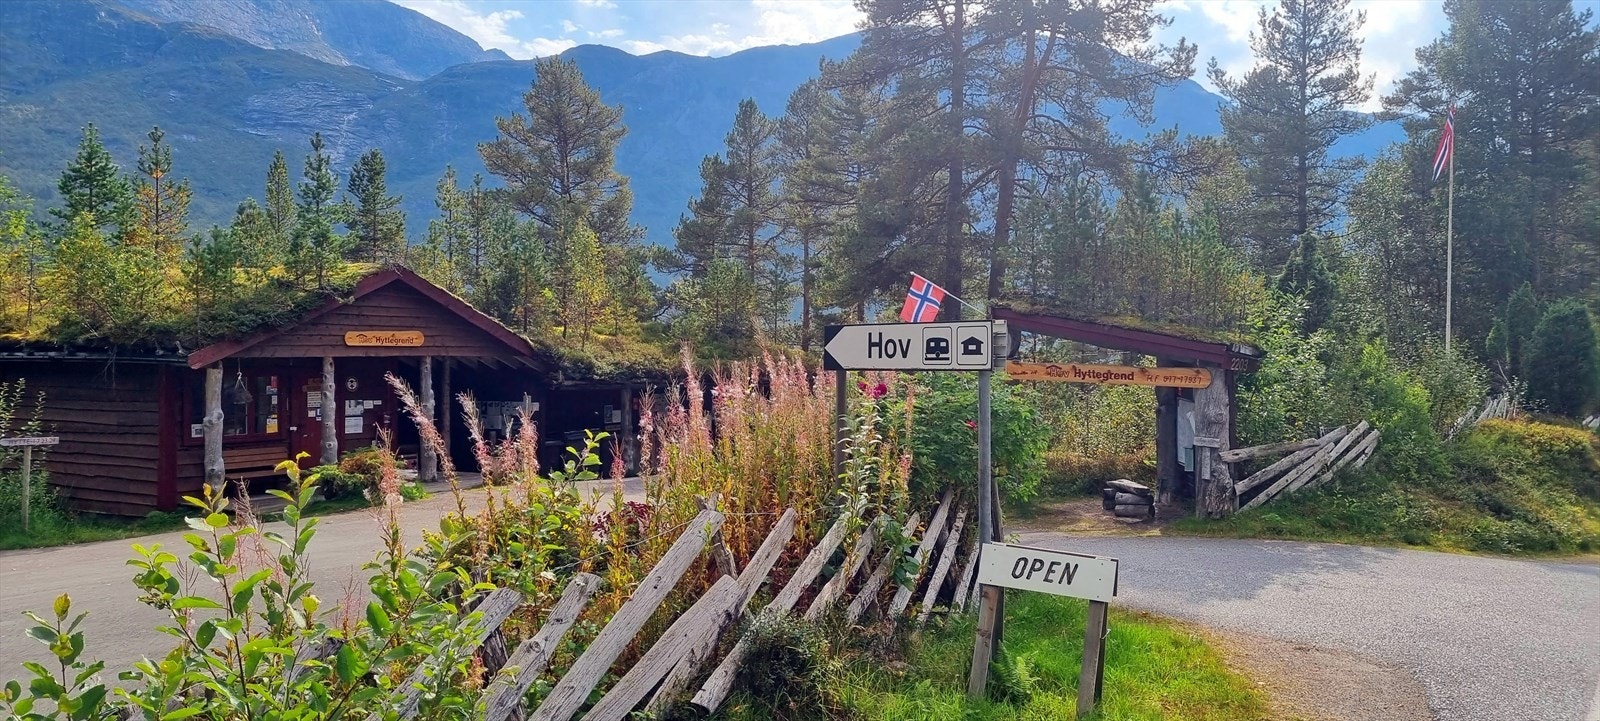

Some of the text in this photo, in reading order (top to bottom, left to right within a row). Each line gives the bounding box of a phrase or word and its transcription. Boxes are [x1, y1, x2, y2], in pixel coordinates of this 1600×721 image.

[375, 336, 414, 345] Hyttegrend
[867, 331, 911, 359] Hov
[1229, 357, 1248, 371] 2203
[1074, 368, 1134, 381] Hyttegrend
[1011, 556, 1079, 586] OPEN
